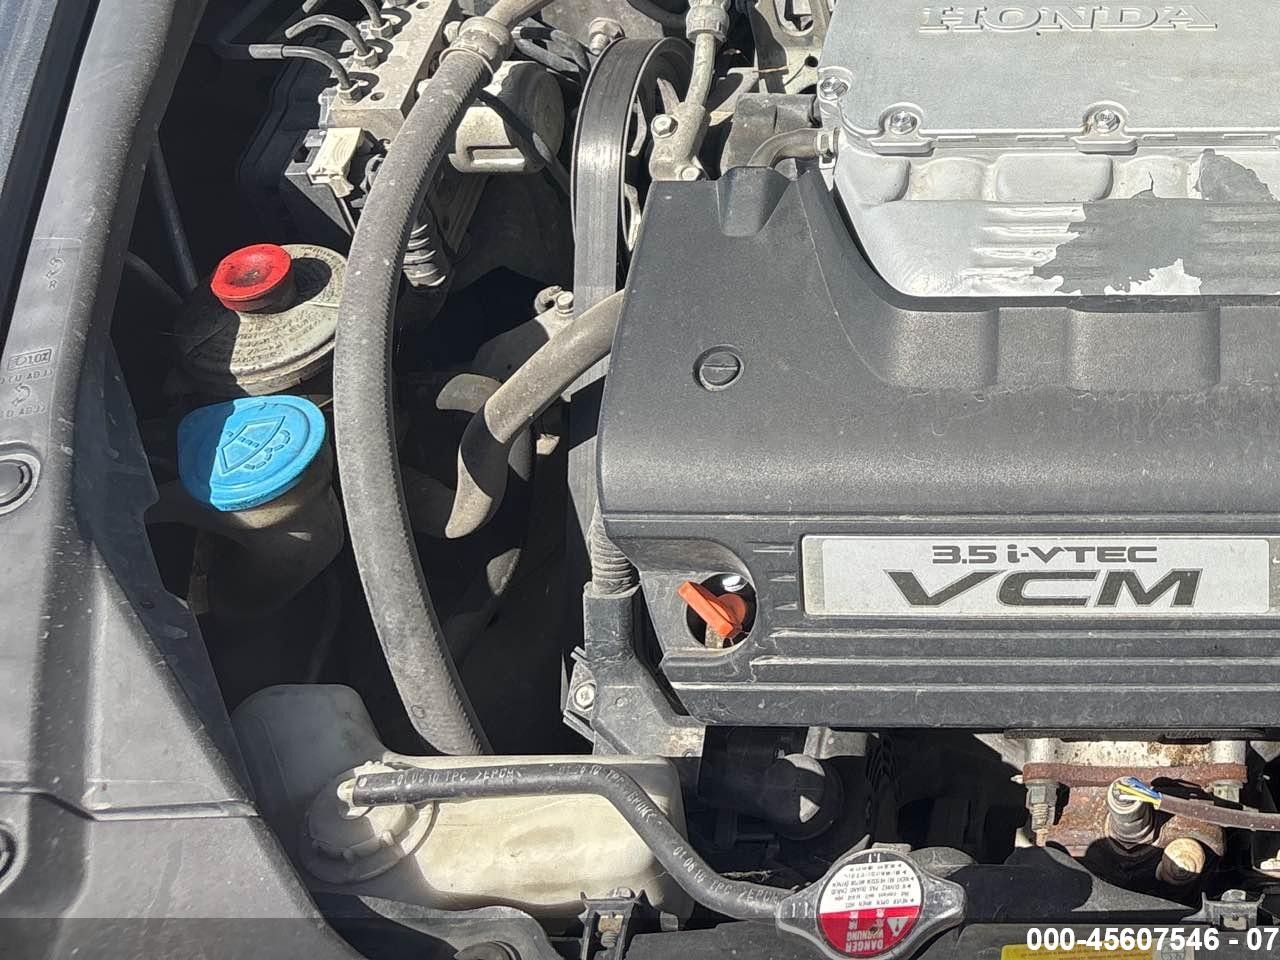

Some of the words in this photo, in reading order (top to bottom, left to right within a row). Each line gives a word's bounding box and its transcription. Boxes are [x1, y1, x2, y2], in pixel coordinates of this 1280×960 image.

[919, 5, 1218, 32] HONDA
[932, 545, 997, 565] 3.5
[1006, 545, 1158, 565] i-VTEC
[883, 568, 1204, 608] VCM
[845, 939, 884, 953] DANGER
